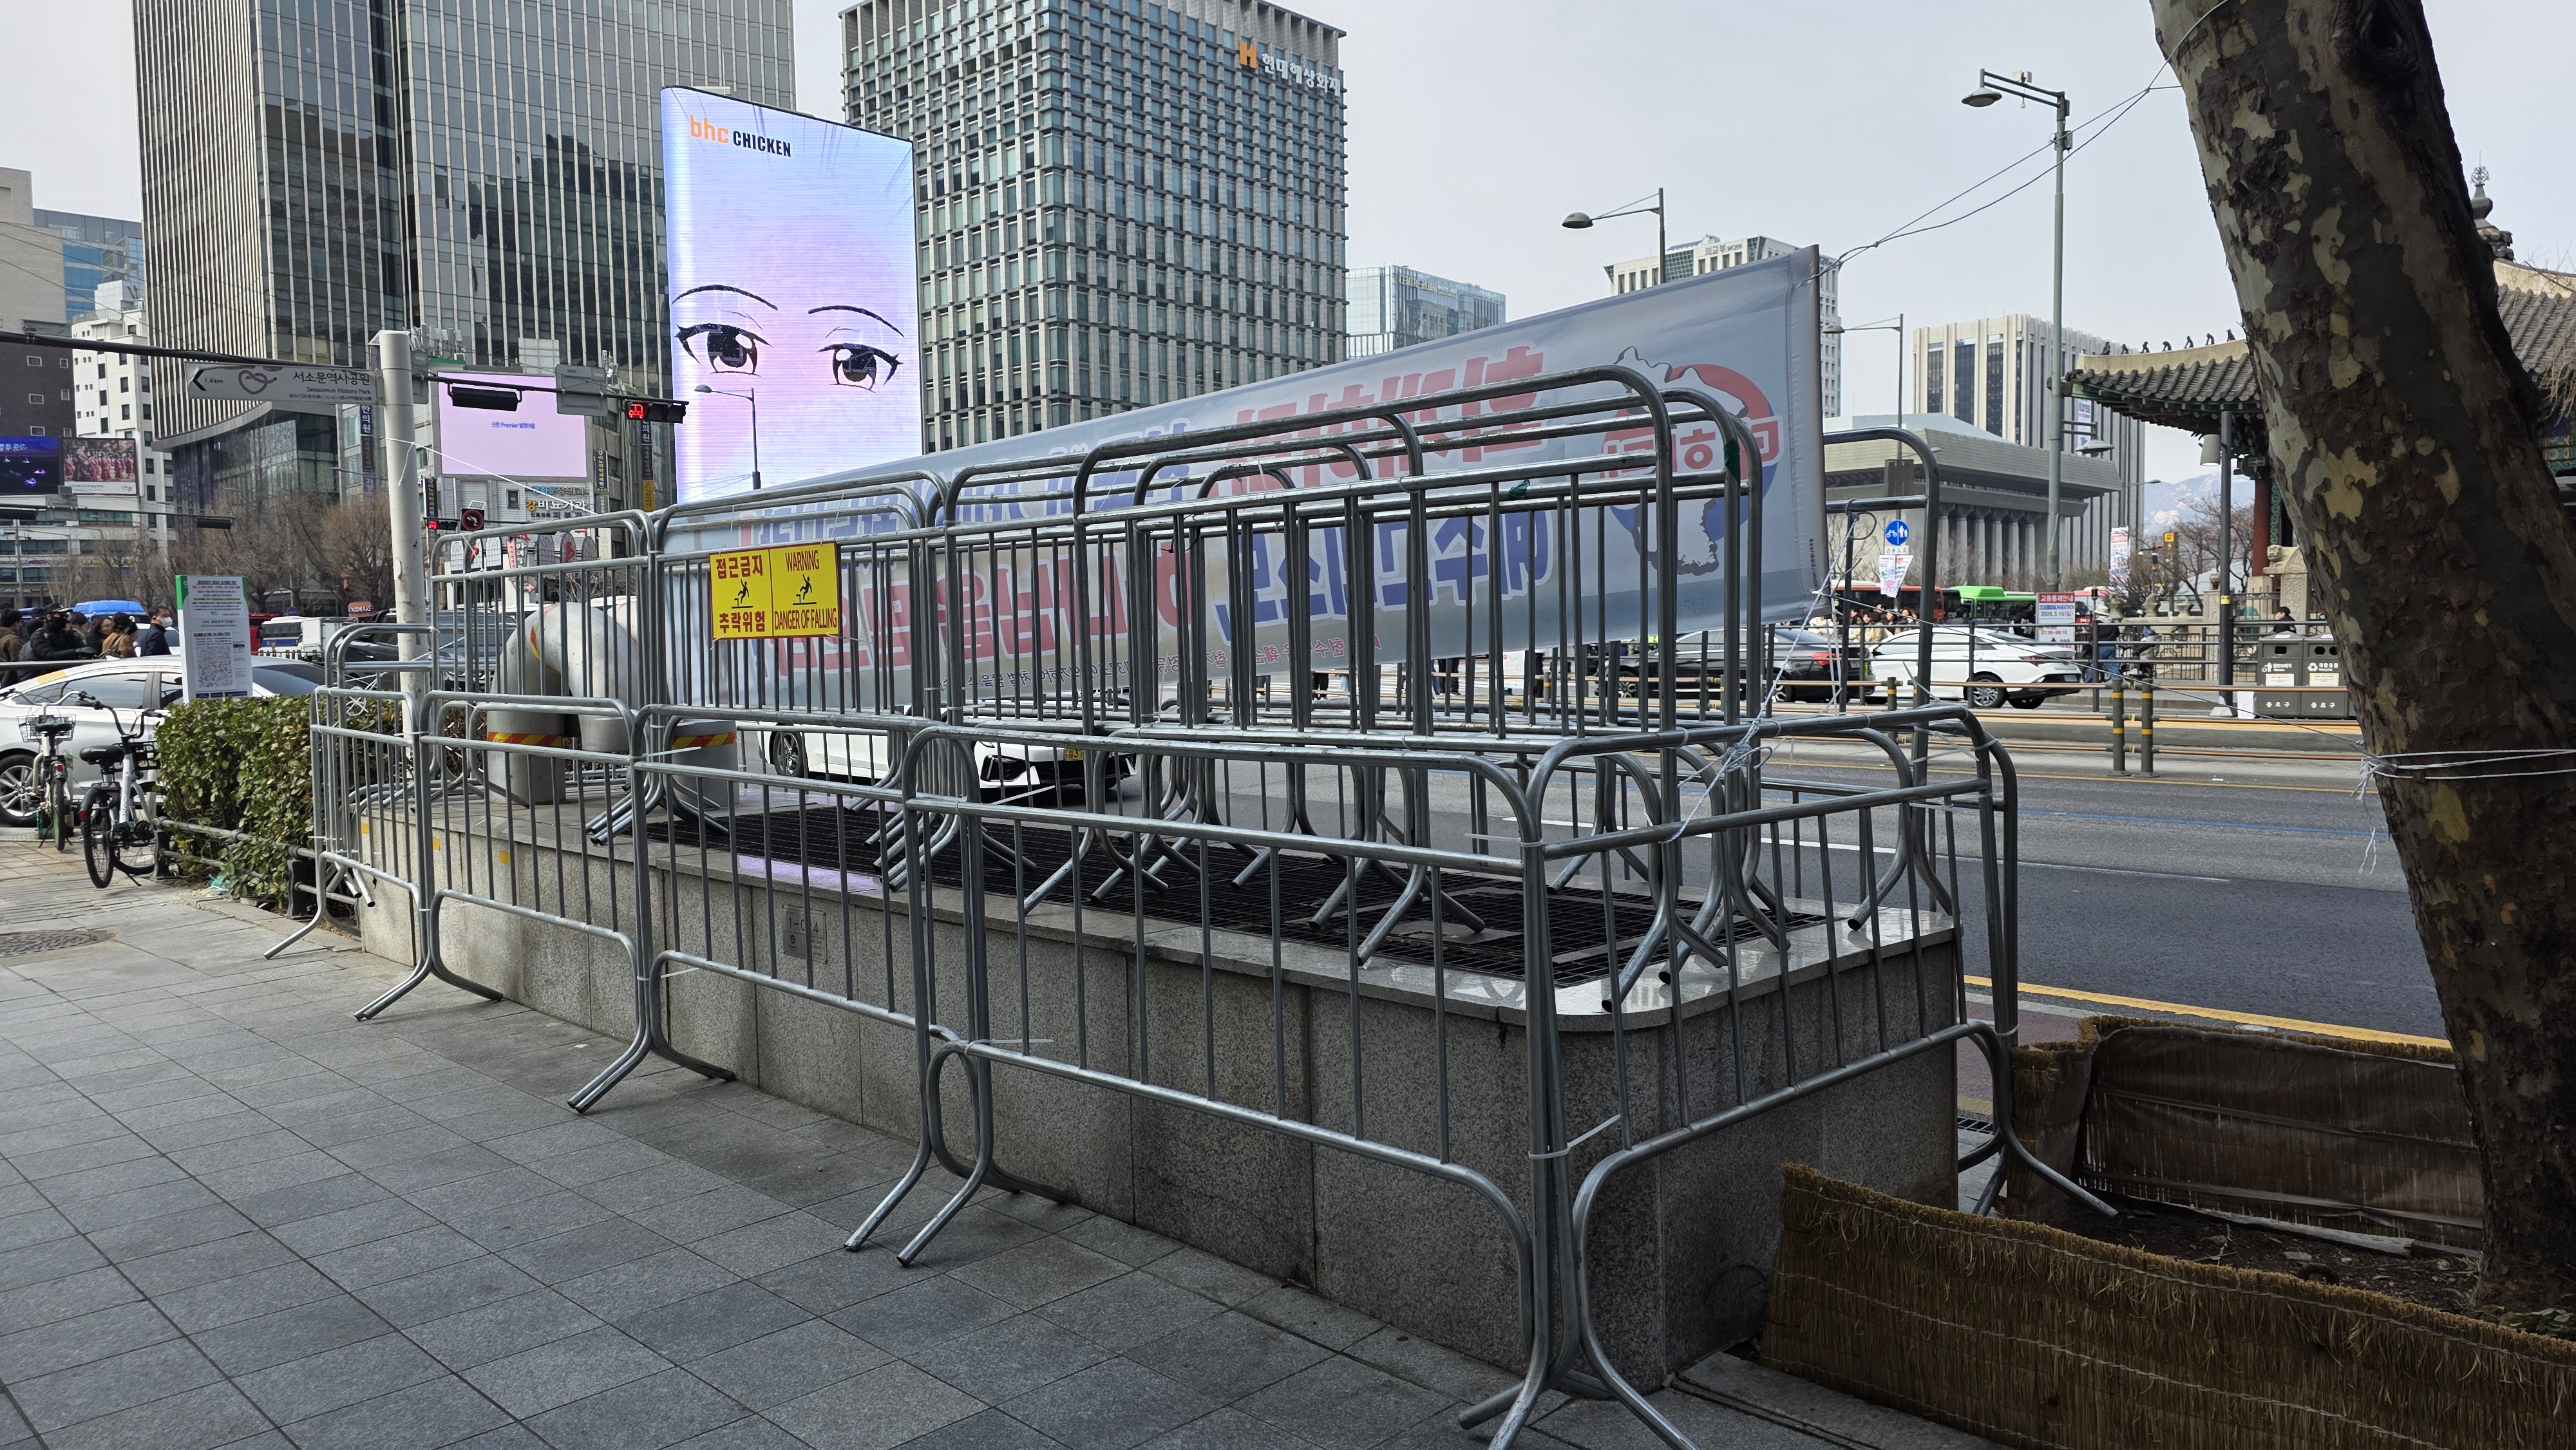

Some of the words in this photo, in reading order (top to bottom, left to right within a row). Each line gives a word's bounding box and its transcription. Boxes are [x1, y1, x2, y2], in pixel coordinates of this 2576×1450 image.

[1262, 53, 1341, 97] 현대해상화재
[690, 114, 729, 144] bhc
[733, 131, 791, 158] CHICKEN
[1705, 243, 1726, 255] 외교부
[293, 371, 370, 386] 서소문역사공원
[361, 405, 371, 433] 한의원
[516, 543, 526, 568] 마녀김
[716, 555, 763, 579] 접근금지
[785, 550, 820, 572] WARNING
[719, 610, 765, 634] 추락위험
[775, 610, 800, 630] DANGER
[801, 609, 810, 629] OF
[811, 608, 837, 628] FALLING
